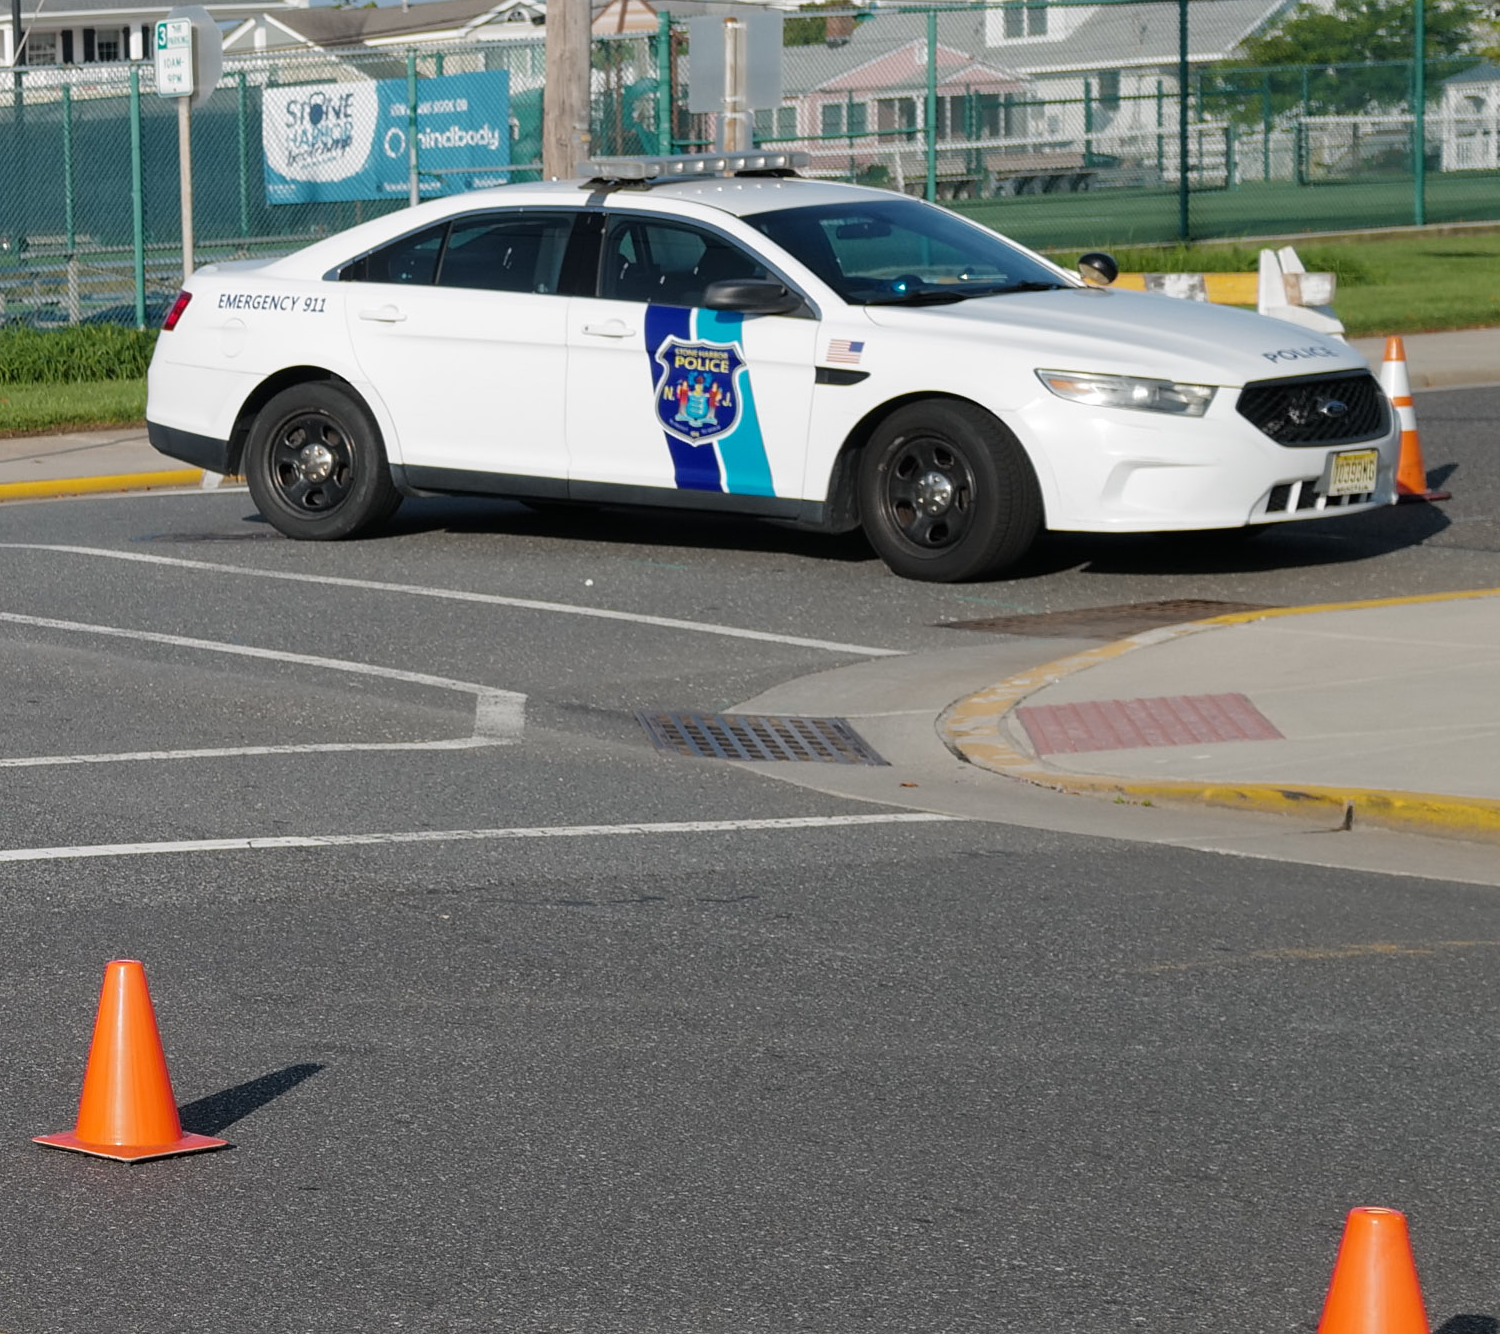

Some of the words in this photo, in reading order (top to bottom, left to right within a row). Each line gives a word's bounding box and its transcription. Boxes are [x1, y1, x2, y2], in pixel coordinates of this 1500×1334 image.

[158, 26, 167, 47] 3
[218, 293, 300, 312] EMERGENCY
[303, 296, 327, 313] 911
[674, 355, 730, 373] POLICE
[1262, 346, 1339, 364] POLICE
